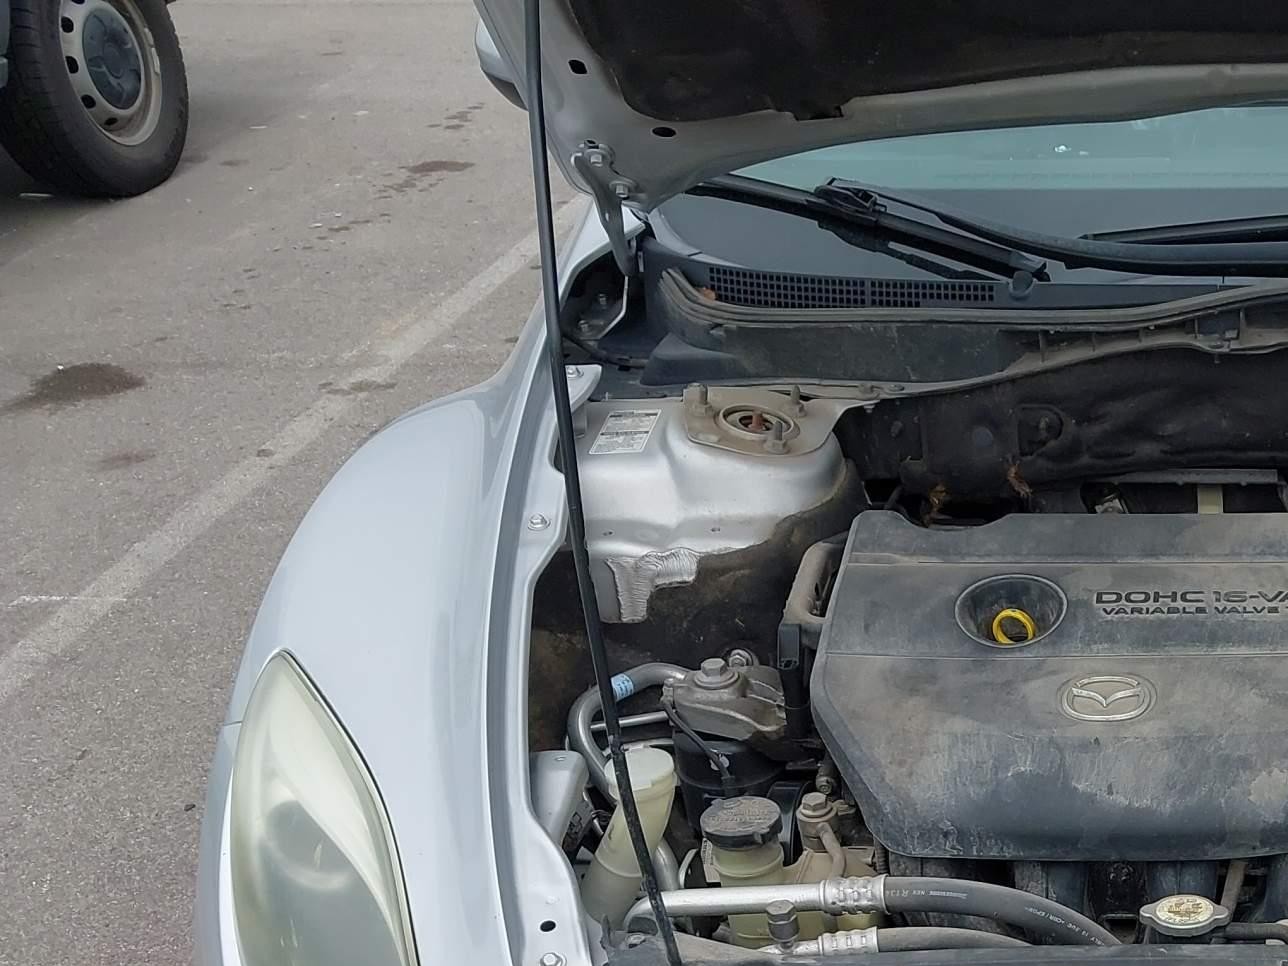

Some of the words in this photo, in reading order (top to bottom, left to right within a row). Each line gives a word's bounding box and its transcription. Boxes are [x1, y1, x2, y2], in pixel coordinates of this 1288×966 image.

[1096, 590, 1205, 604] DOHC
[1102, 606, 1209, 616] VARIABLE
[1214, 605, 1280, 615] VALVE
